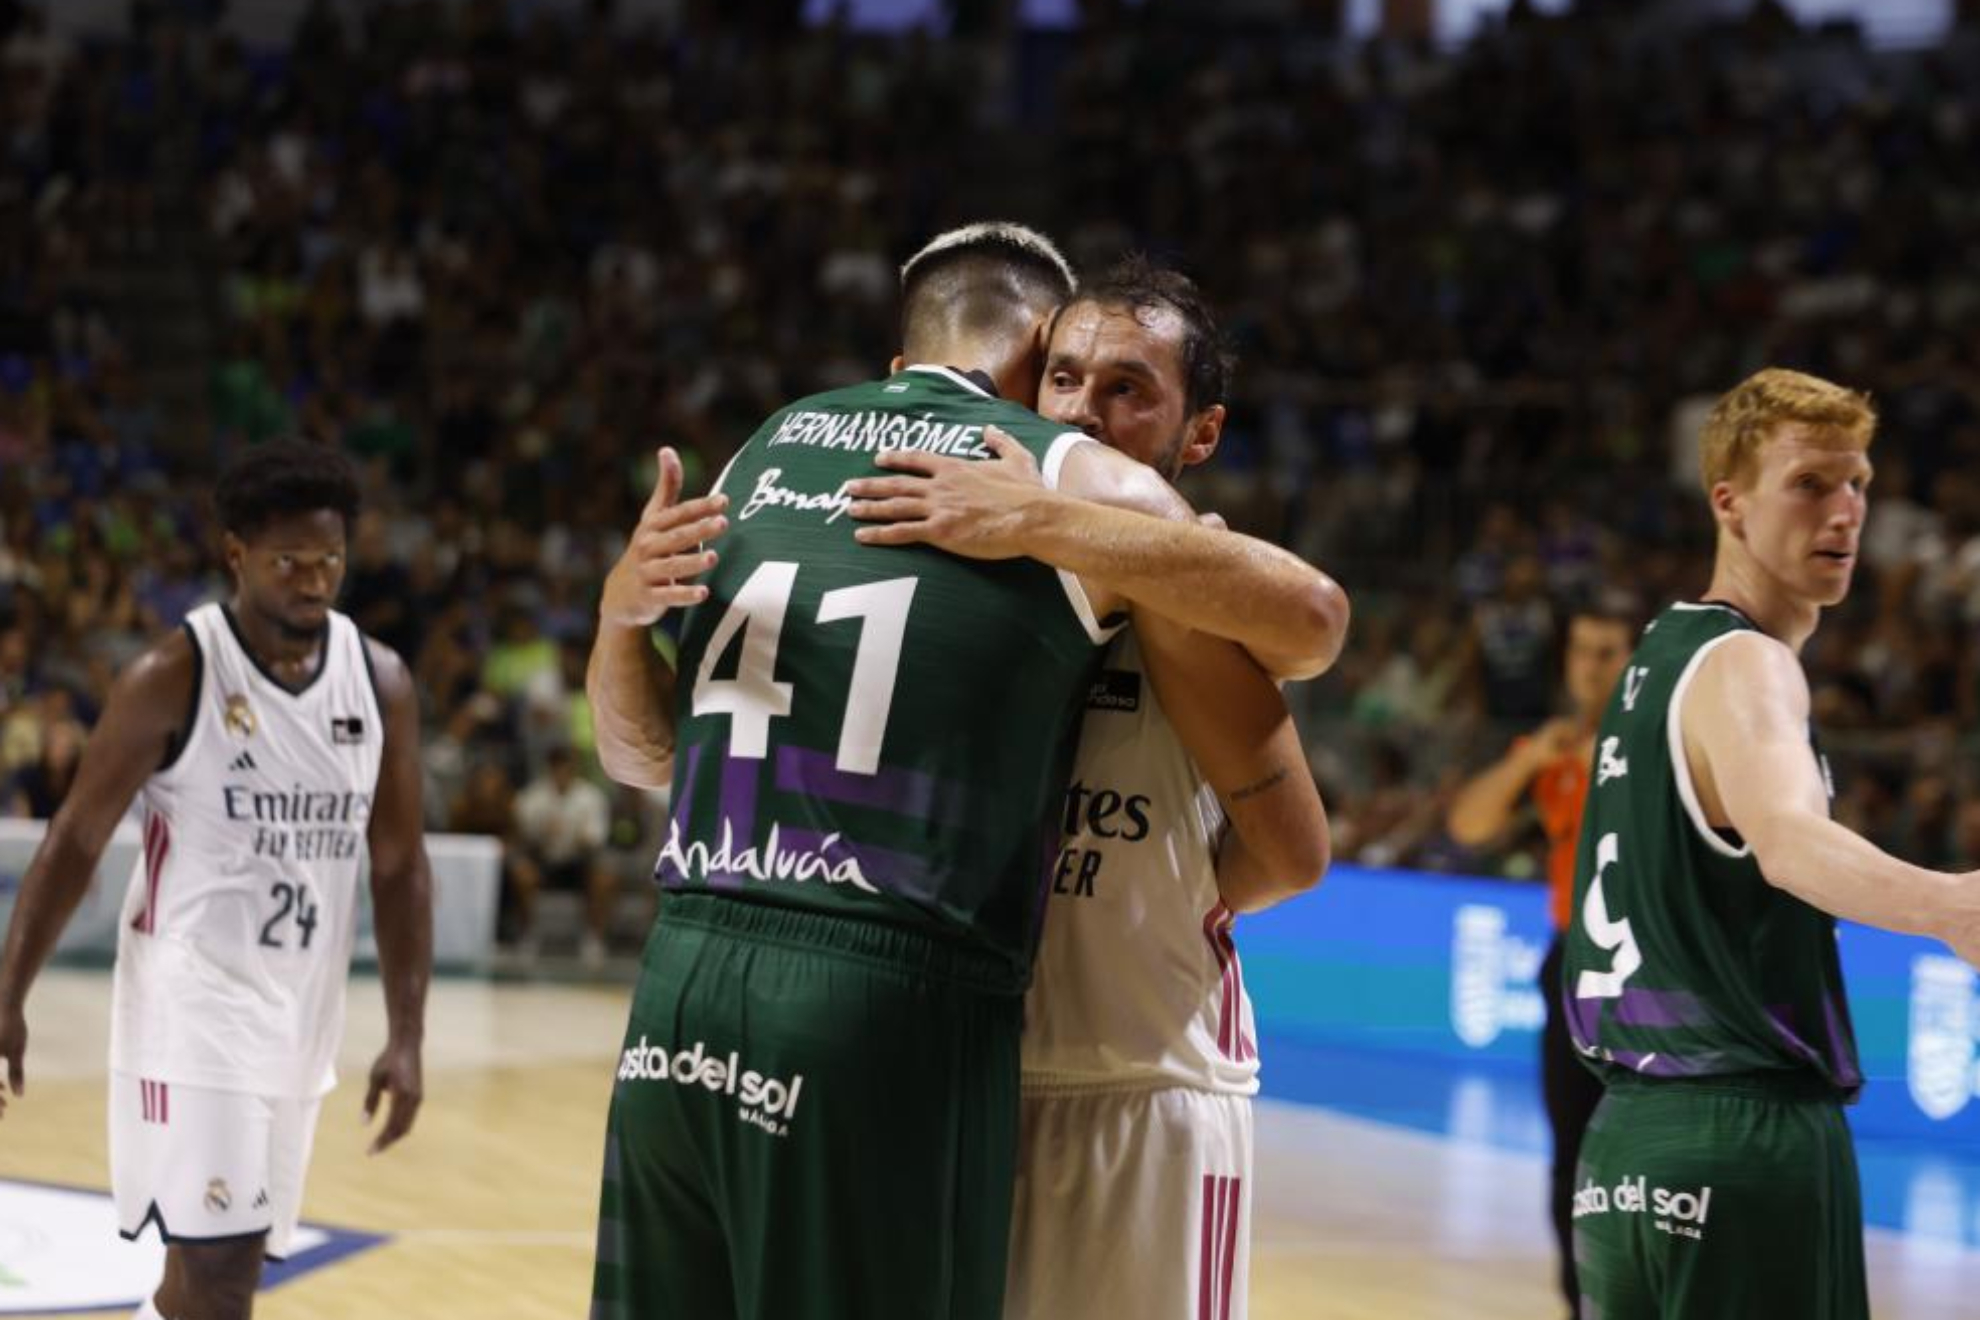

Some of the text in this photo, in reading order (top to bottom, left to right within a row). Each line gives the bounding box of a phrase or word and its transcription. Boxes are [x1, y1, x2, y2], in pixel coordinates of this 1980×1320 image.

[691, 560, 919, 775] 41
[655, 817, 880, 893] Andalucía
[258, 882, 317, 948] 24
[1576, 832, 1643, 999] 5
[670, 1042, 739, 1095] del
[739, 1070, 804, 1119] sol
[1613, 1175, 1647, 1212] del
[1652, 1187, 1712, 1224] sol
